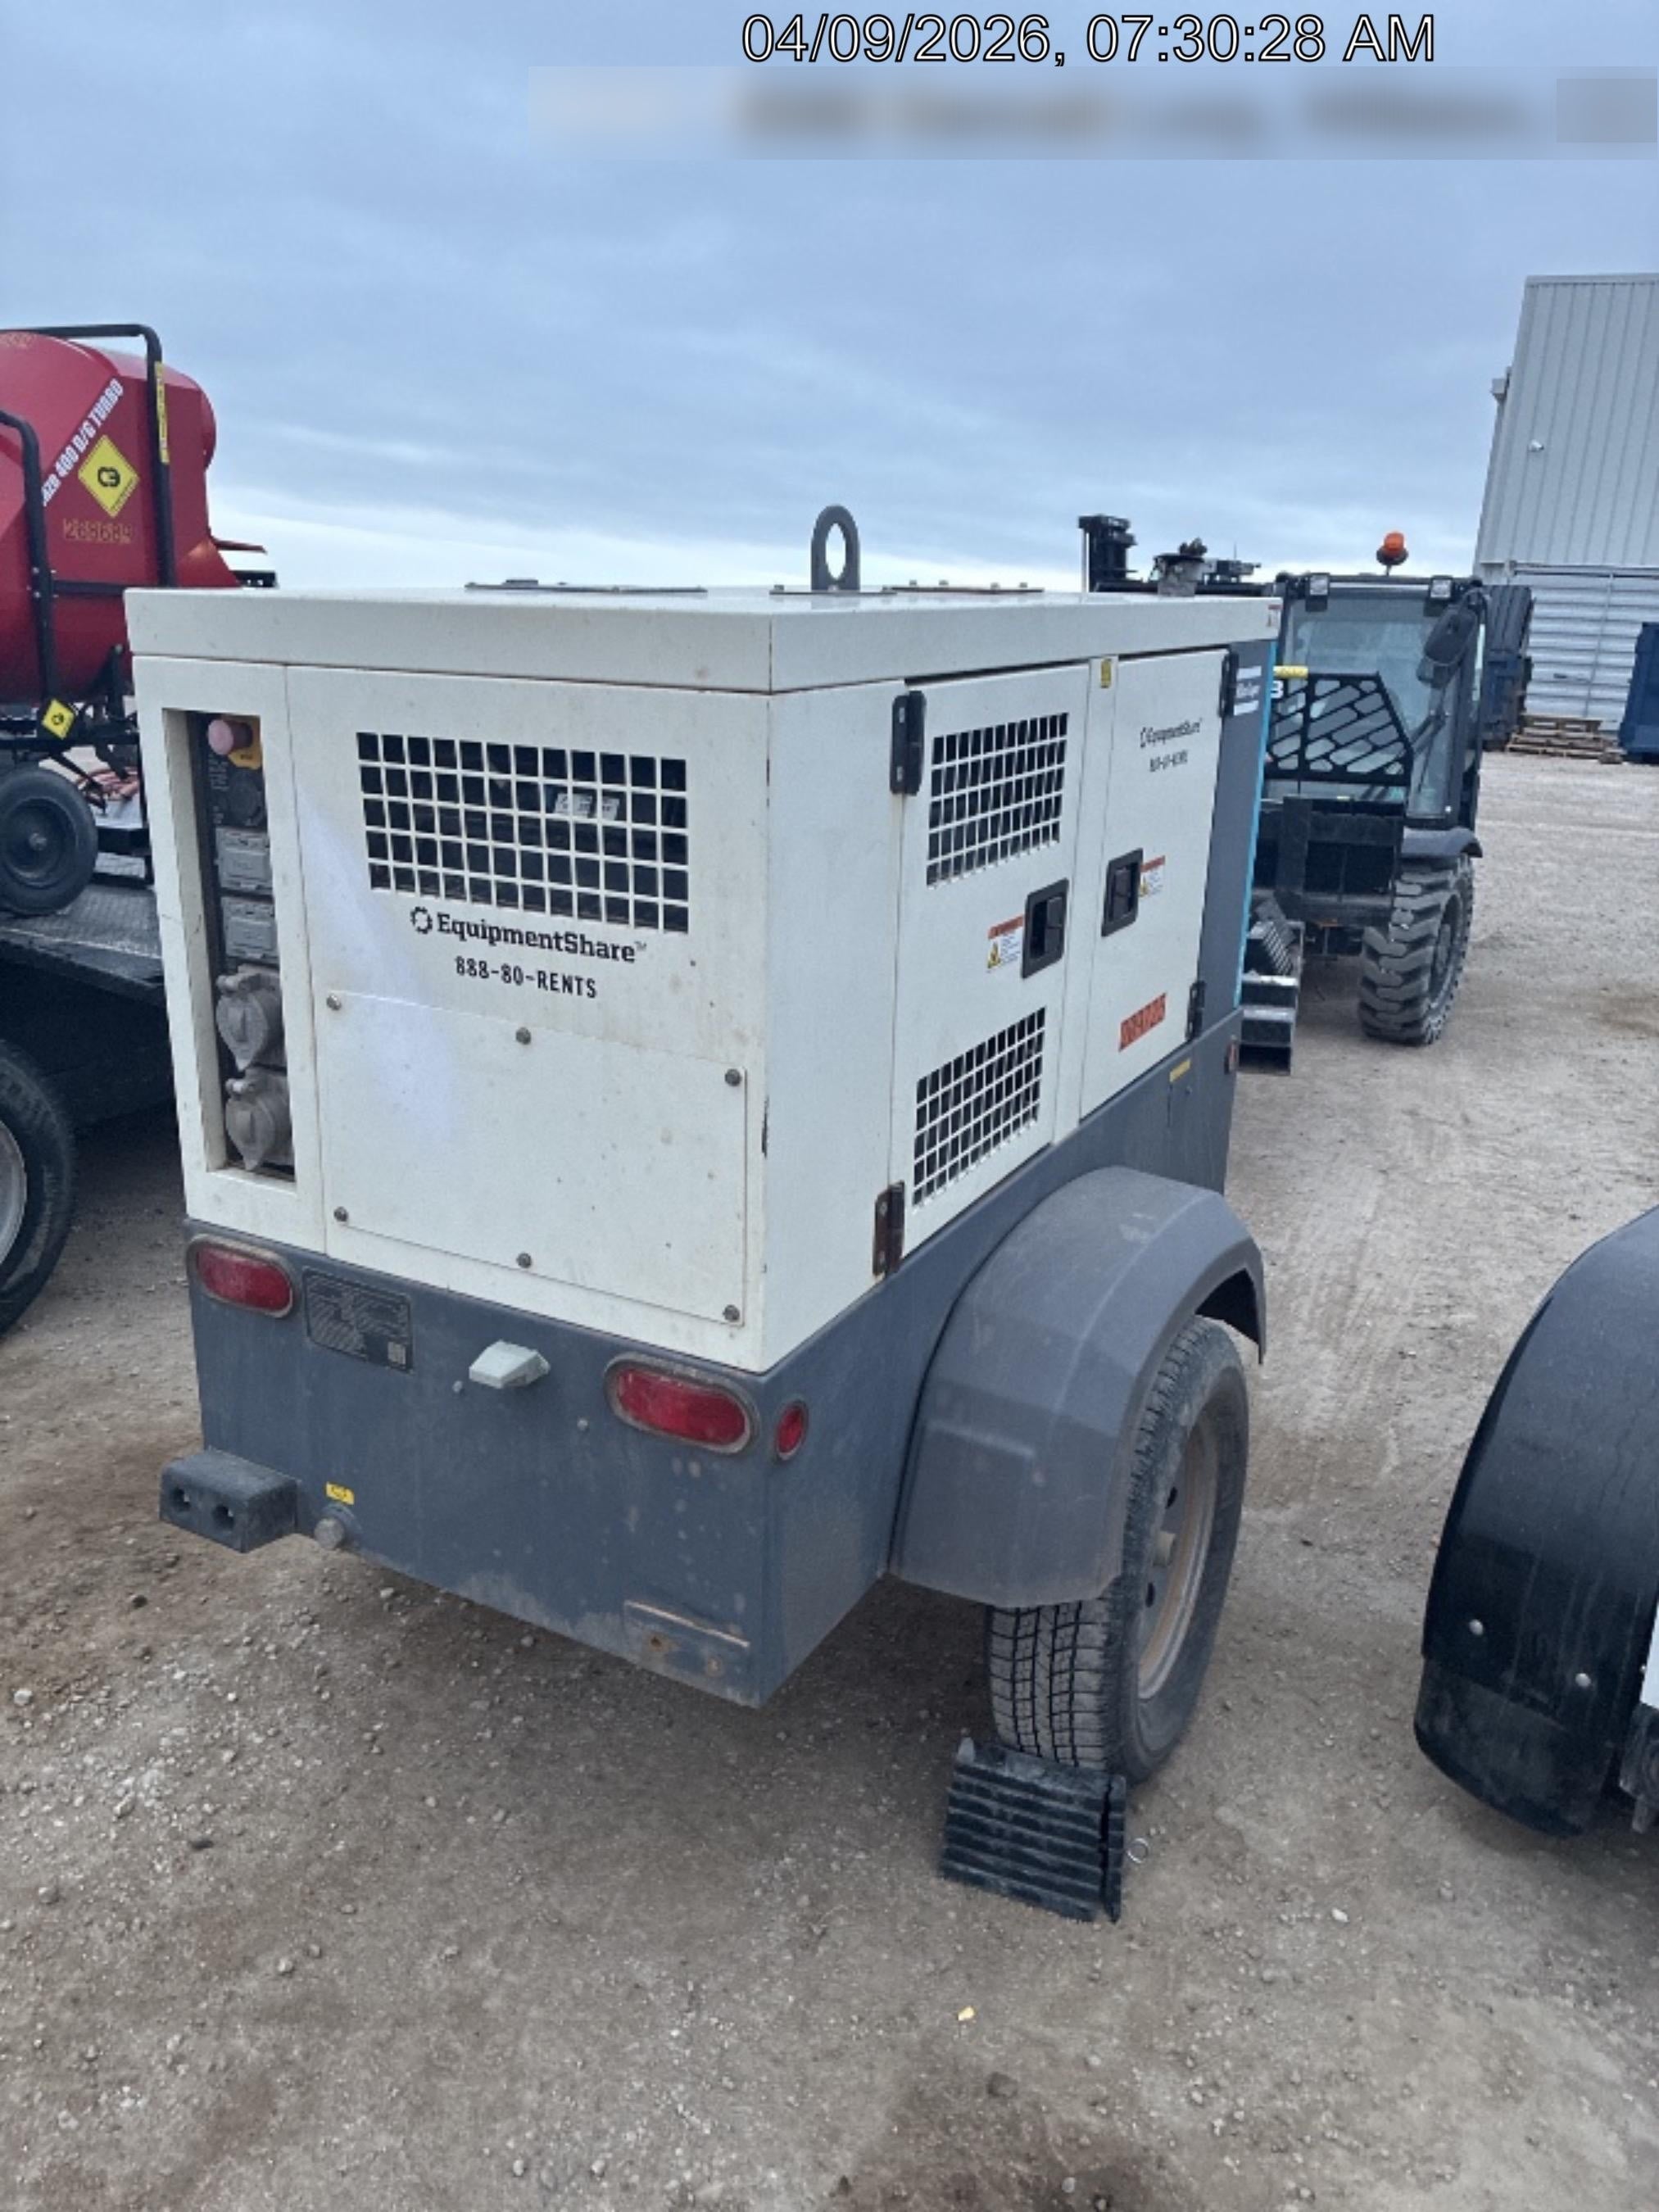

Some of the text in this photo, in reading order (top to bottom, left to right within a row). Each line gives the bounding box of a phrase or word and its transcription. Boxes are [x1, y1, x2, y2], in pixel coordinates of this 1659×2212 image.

[54, 445, 79, 477] 400
[88, 377, 124, 428] TURBO
[437, 912, 636, 963] EquipmentShare
[455, 955, 597, 999] 888-80-RENTS
